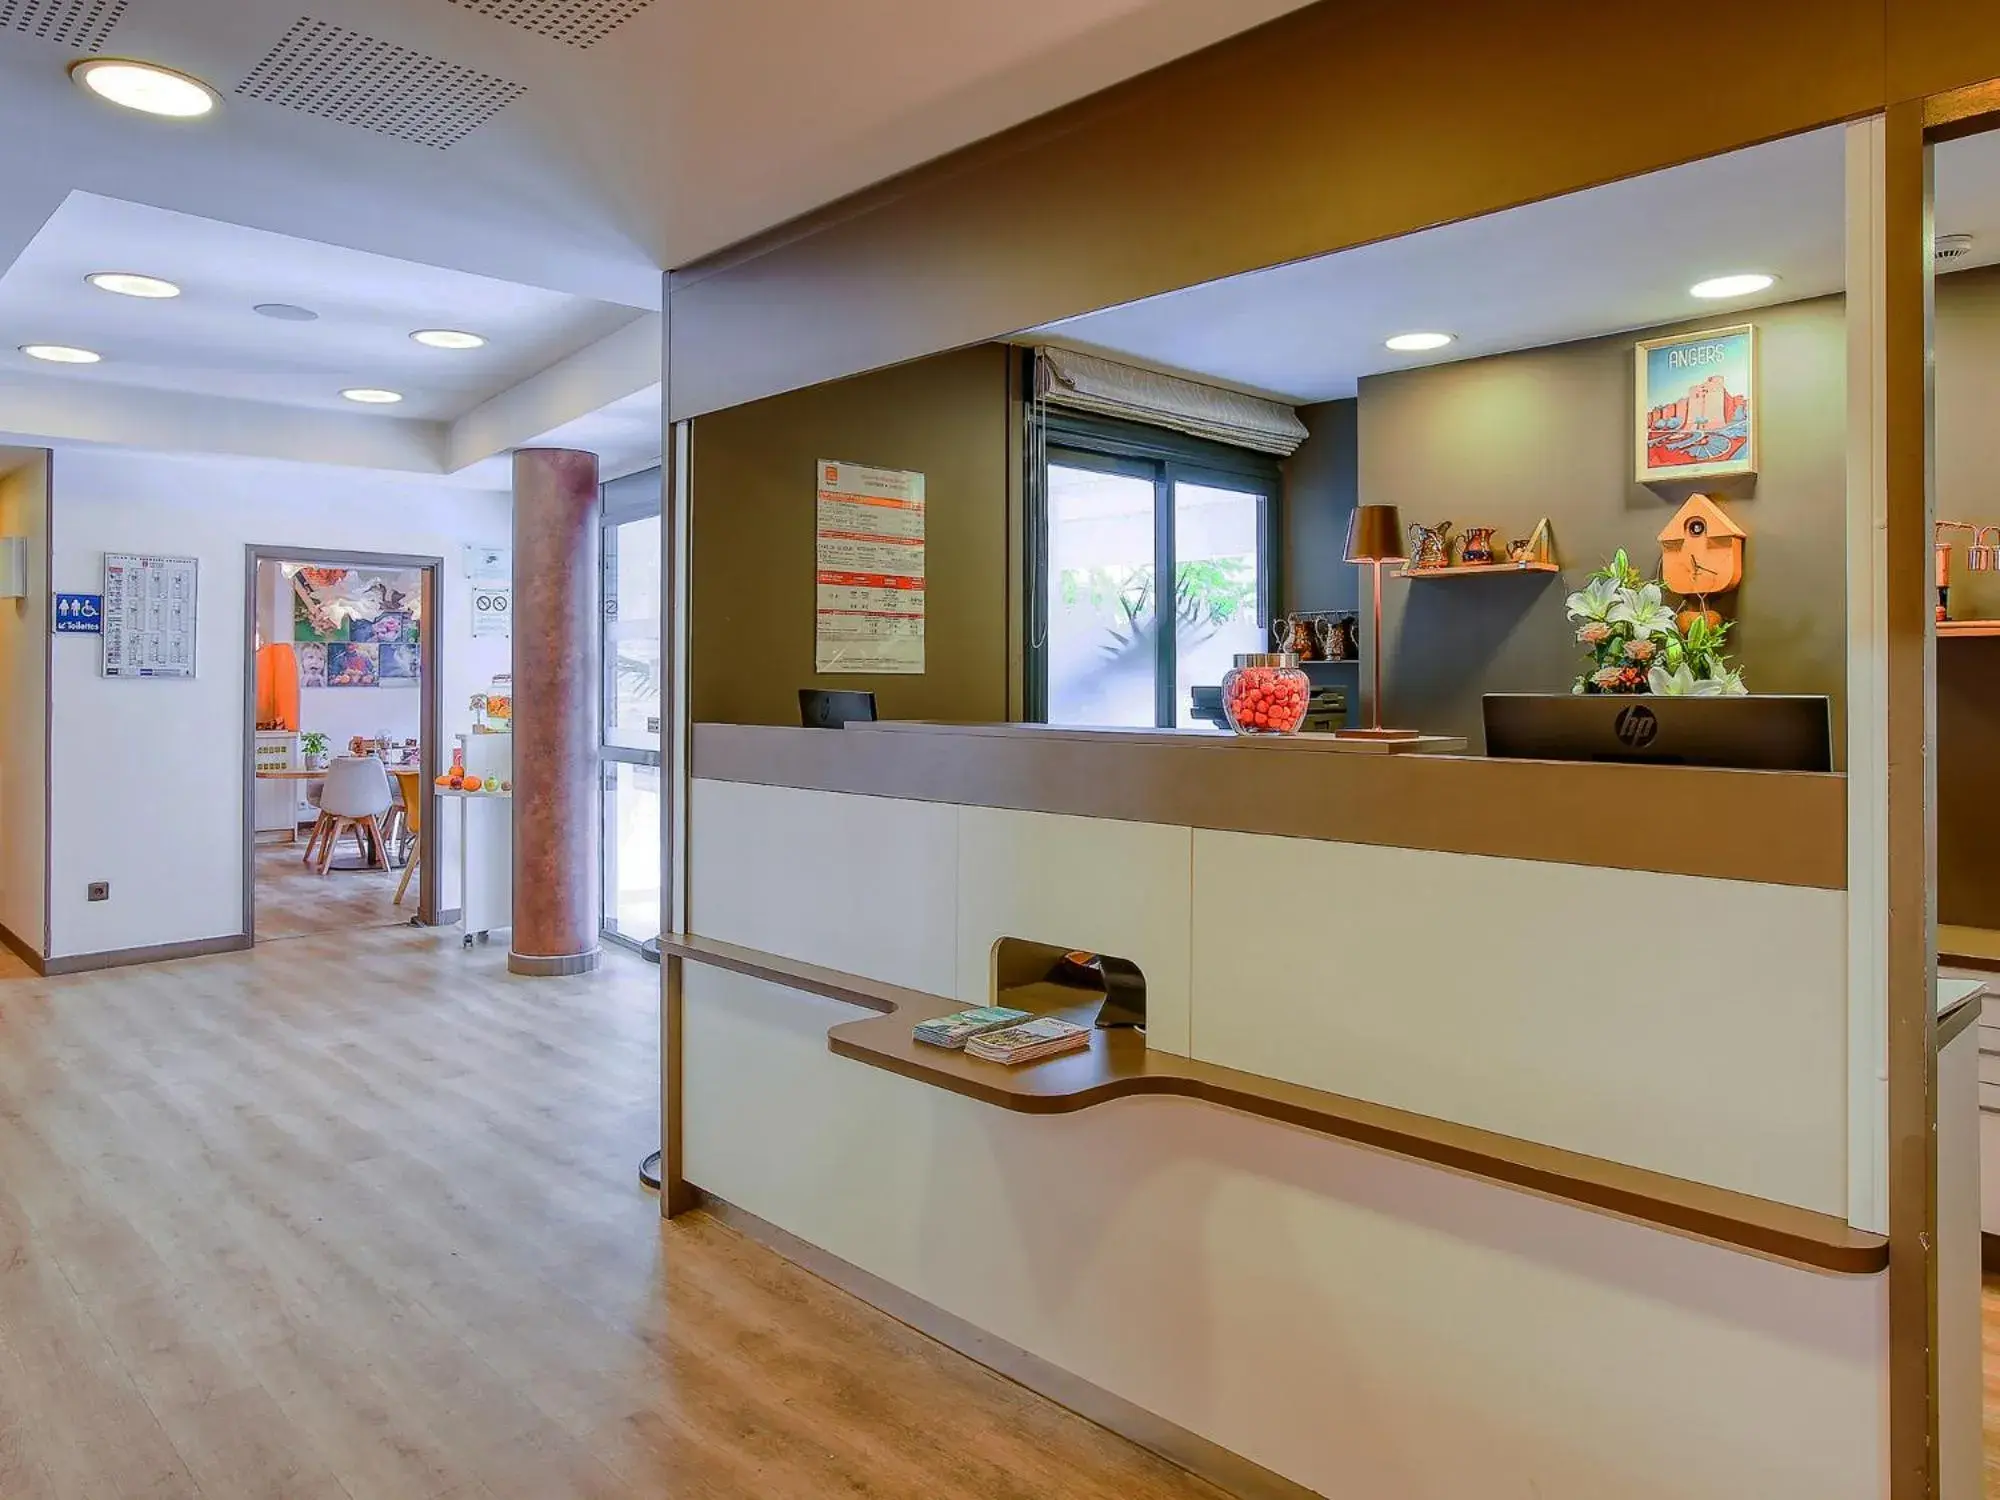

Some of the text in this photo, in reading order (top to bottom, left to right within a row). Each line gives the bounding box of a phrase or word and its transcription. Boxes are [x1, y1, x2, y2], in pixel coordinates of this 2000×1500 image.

[1668, 344, 1725, 369] ANGERS
[67, 621, 99, 630] Toilettes
[1620, 705, 1654, 746] hp
